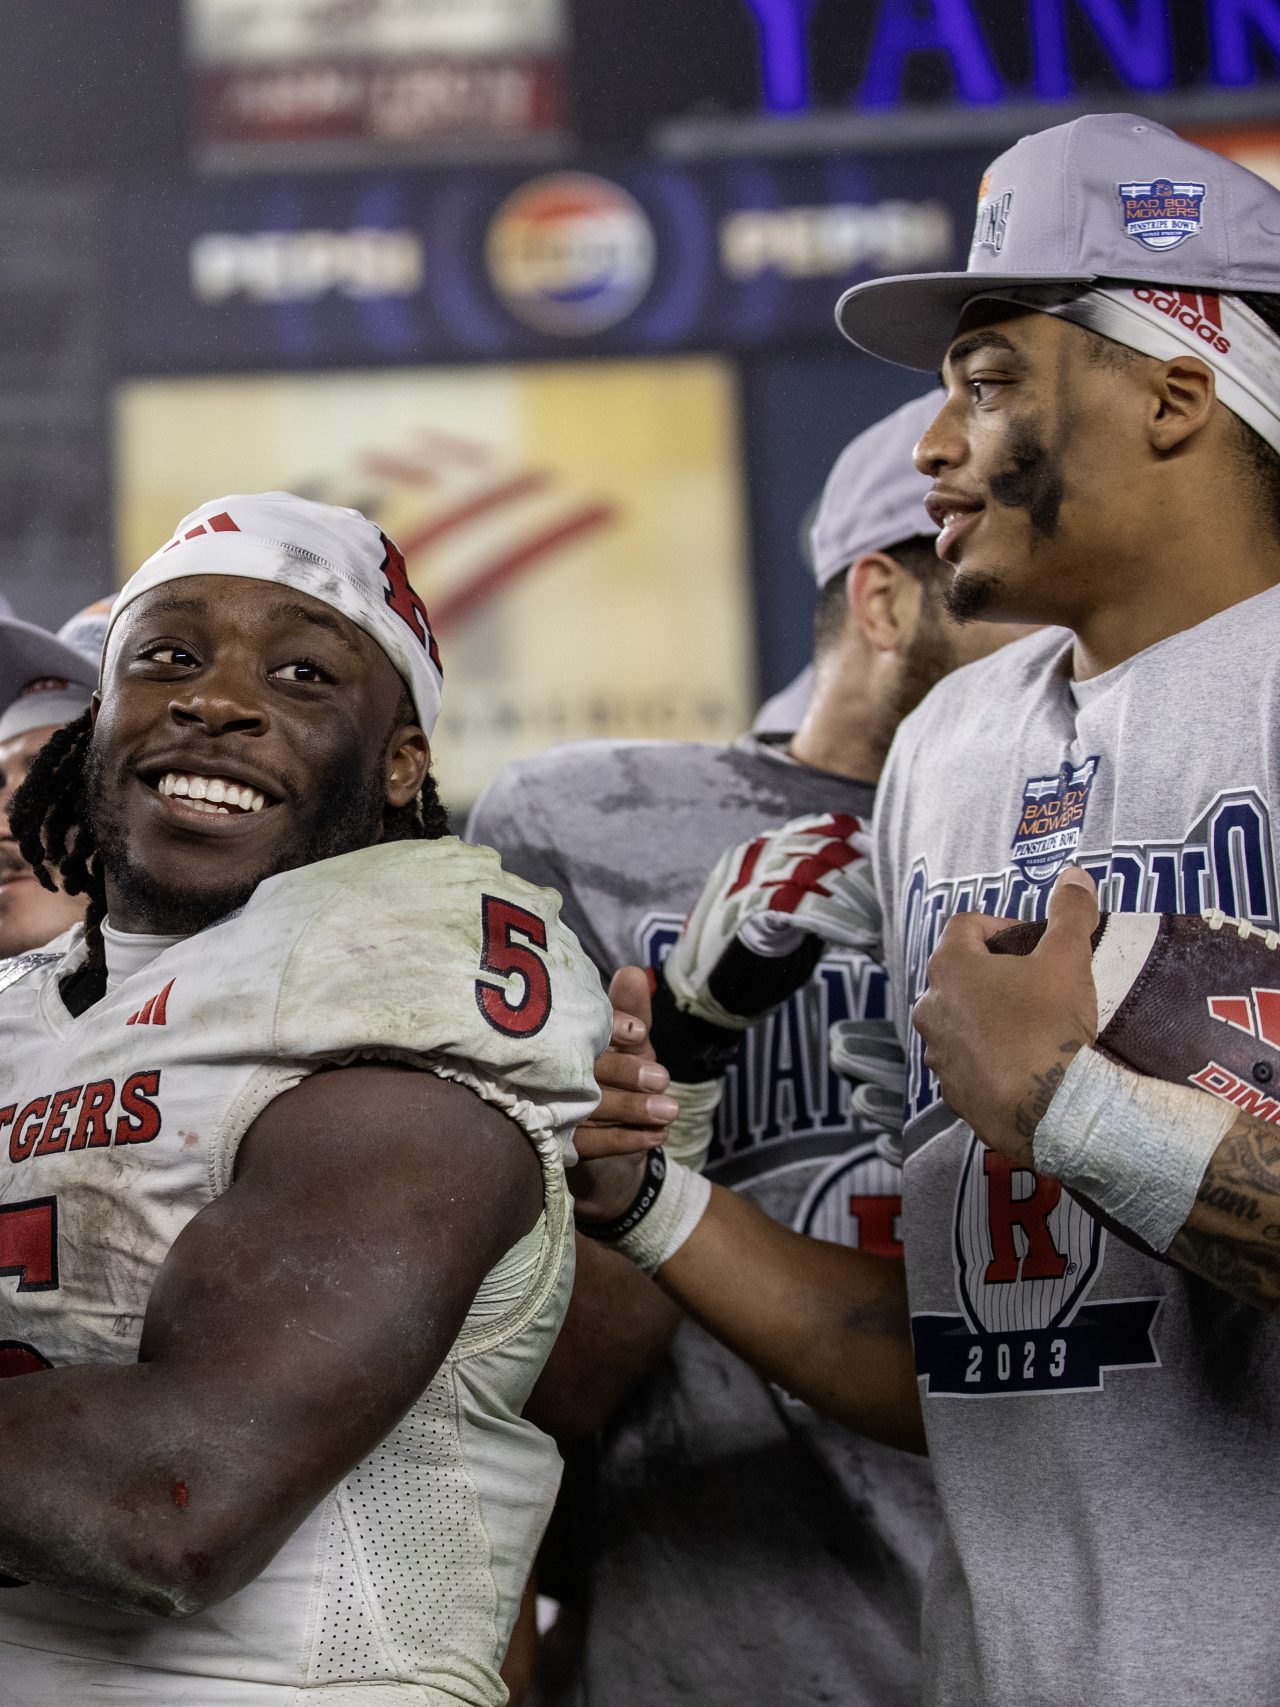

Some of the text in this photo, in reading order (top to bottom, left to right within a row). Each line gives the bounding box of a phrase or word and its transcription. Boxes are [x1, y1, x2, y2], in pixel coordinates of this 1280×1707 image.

[1126, 198, 1198, 209] BAD BOY
[1126, 207, 1199, 219] MOWERS
[1129, 220, 1196, 233] PINSTRIPE BOWL
[1132, 286, 1231, 354] adidas
[1024, 801, 1061, 820] BAD
[474, 893, 552, 1038] 5
[1187, 1060, 1280, 1126] DIM
[983, 1149, 1069, 1286] R
[964, 1338, 1068, 1383] 2023
